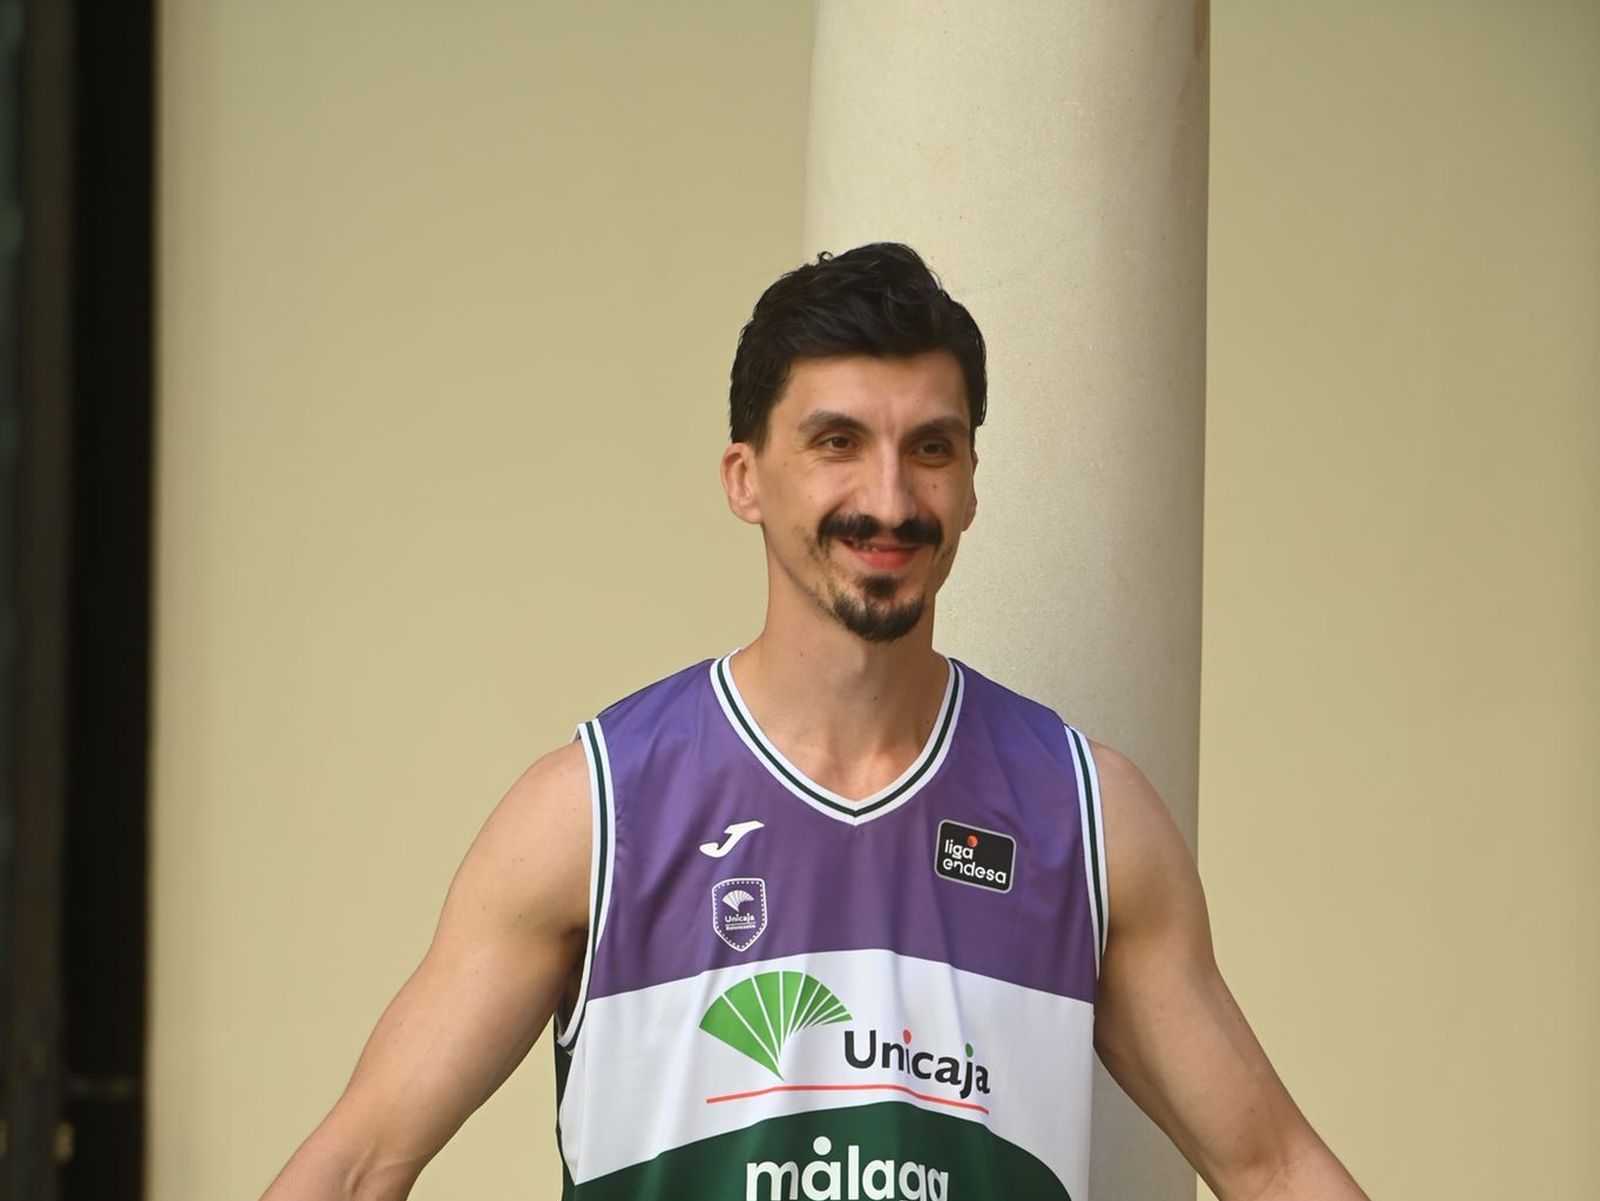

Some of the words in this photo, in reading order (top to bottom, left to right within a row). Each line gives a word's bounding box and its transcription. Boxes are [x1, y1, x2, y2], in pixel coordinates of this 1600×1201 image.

[944, 839, 974, 860] liga
[942, 858, 1007, 884] endesa
[844, 1029, 990, 1099] Unicaja
